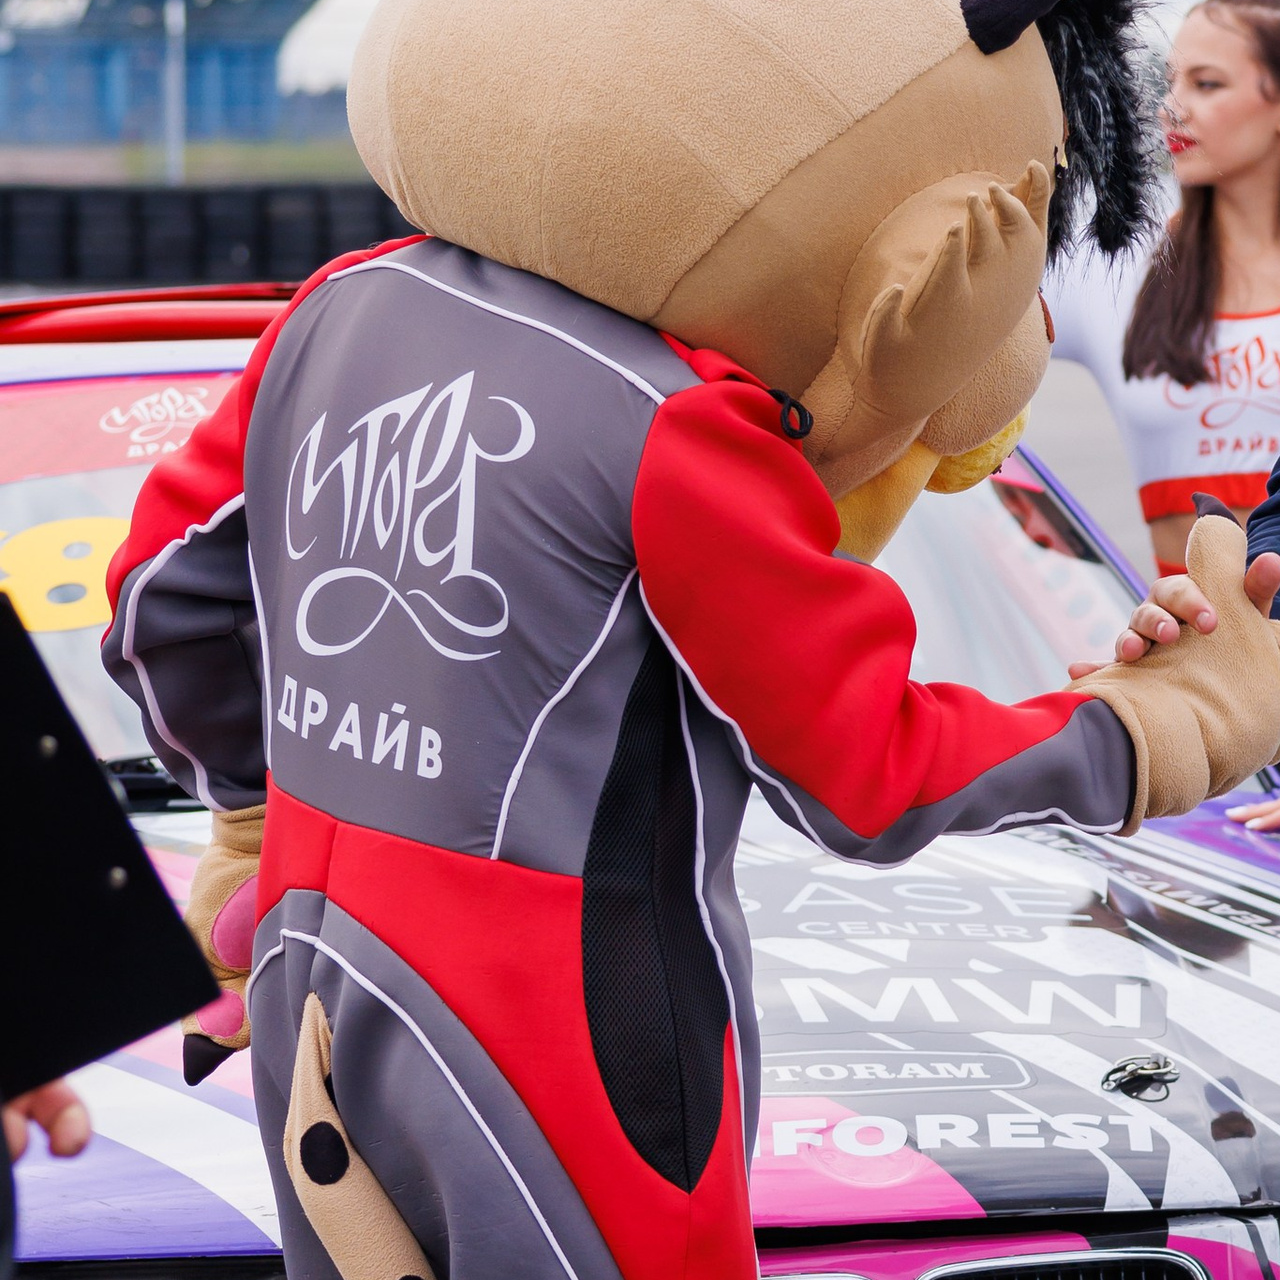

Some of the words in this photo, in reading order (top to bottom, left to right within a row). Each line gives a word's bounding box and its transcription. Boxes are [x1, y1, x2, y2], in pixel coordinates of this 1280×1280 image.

[276, 674, 444, 780] ДРАЙВ
[797, 921, 1033, 940] CENTER
[756, 976, 1145, 1029] MW
[753, 1113, 1169, 1158] FOREST
